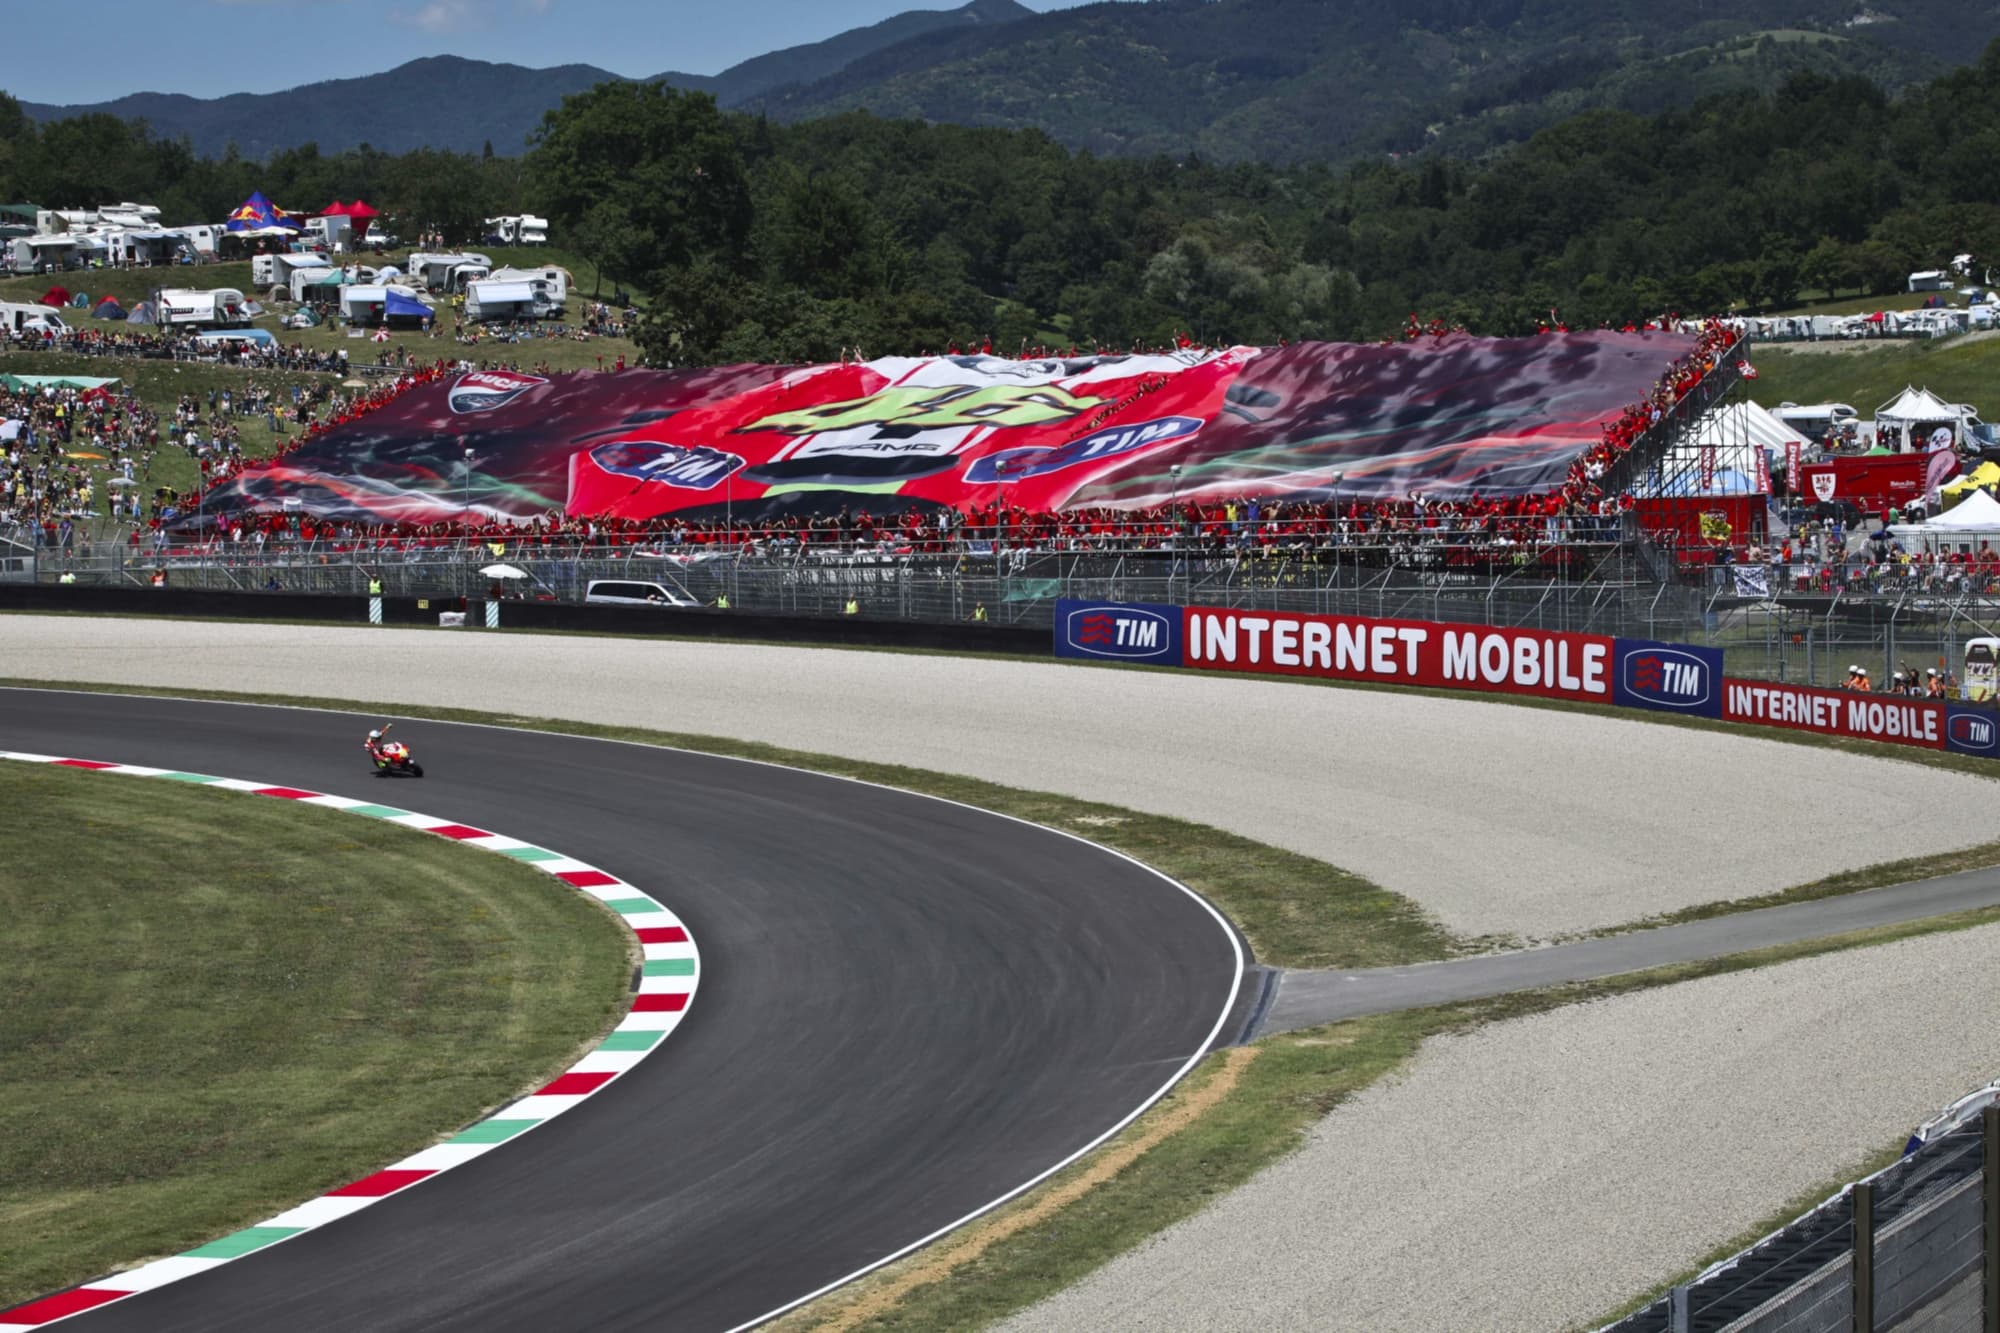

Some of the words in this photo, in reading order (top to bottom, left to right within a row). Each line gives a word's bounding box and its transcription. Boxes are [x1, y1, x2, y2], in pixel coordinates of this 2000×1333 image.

[1081, 422, 1181, 456] TIM
[639, 452, 728, 482] TIM
[1788, 444, 1798, 489] DUCATI
[1115, 618, 1158, 648] TIM
[1190, 613, 1427, 676] INTERNET
[1442, 630, 1606, 693] MOBILE
[1662, 661, 1699, 697] TIM
[1728, 685, 1841, 729] INTERNET
[1848, 700, 1938, 741] MOBILE
[1970, 722, 1990, 743] TIM
